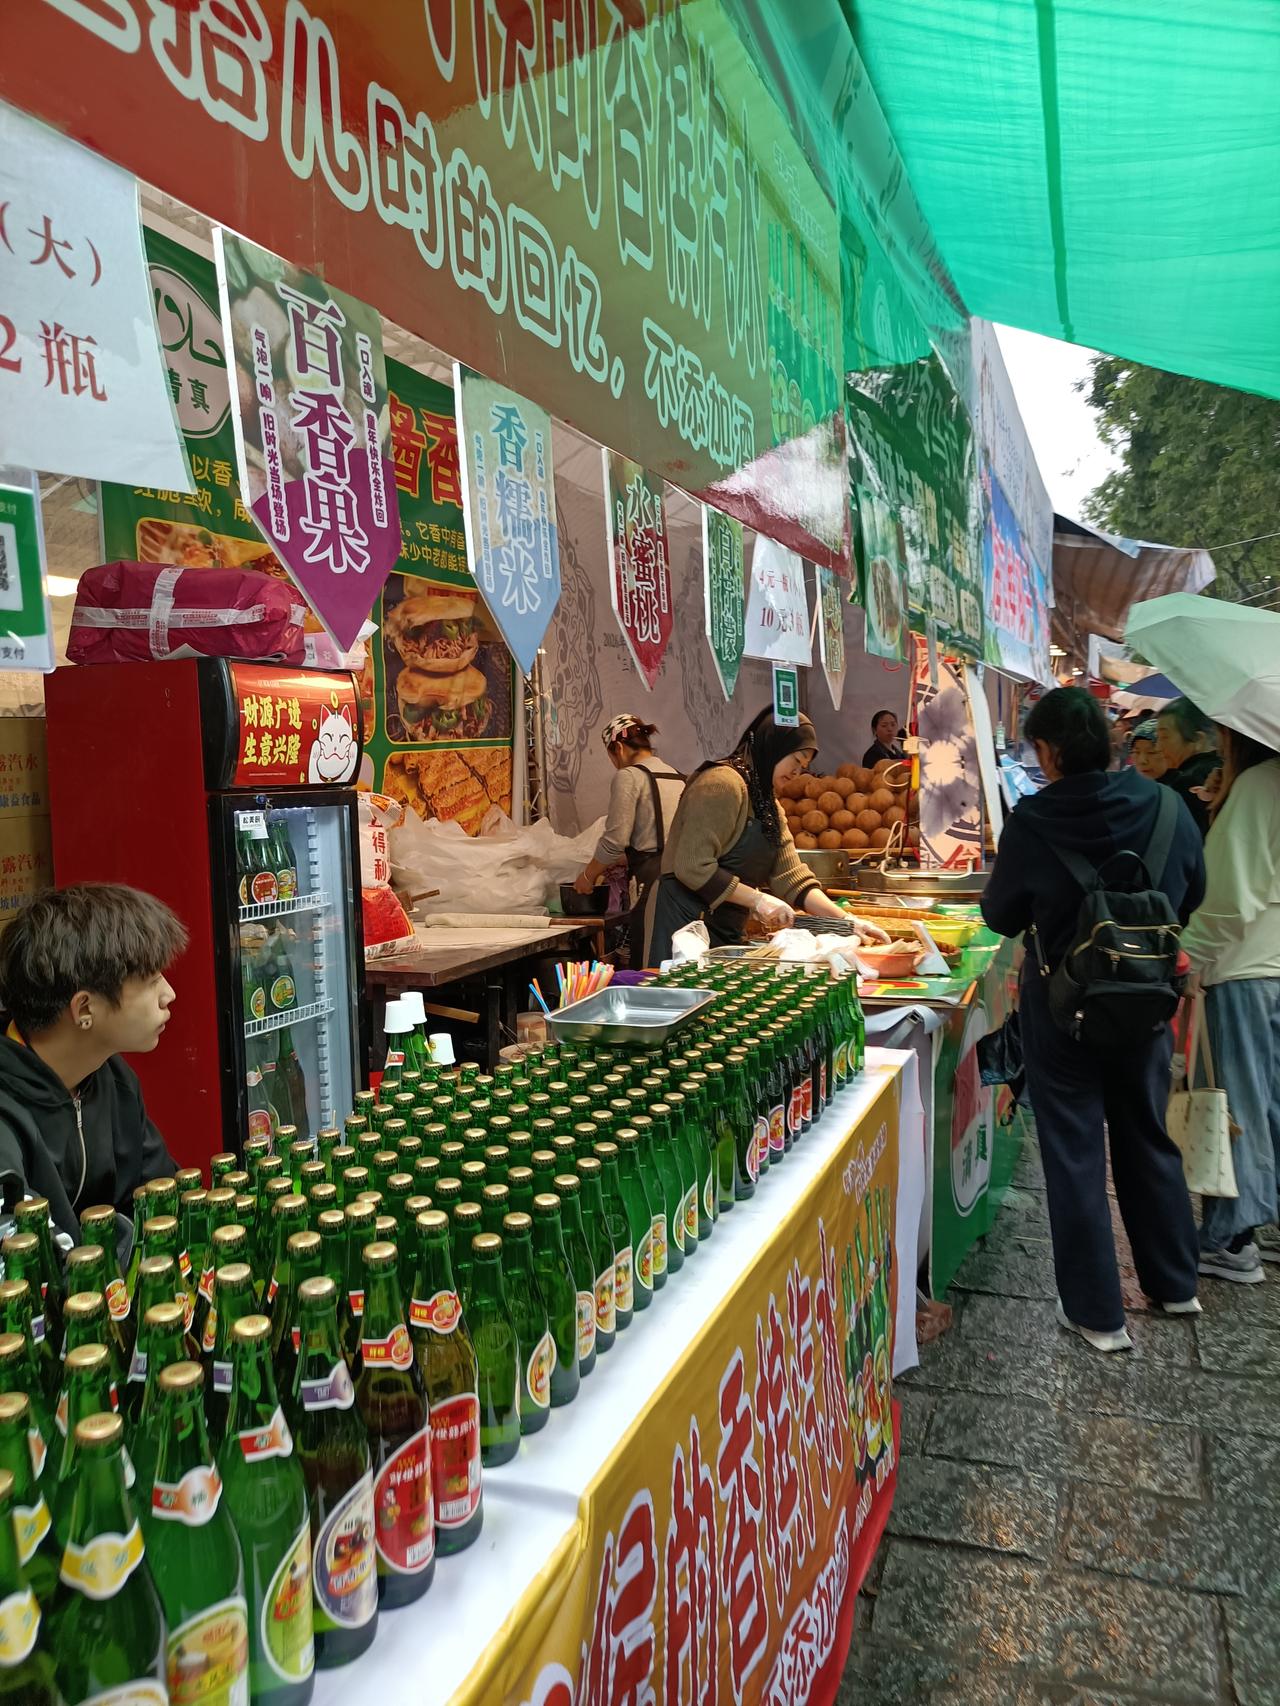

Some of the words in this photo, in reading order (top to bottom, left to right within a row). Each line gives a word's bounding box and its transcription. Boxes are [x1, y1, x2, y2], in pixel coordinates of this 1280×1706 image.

[40, 0, 625, 399] 拾儿时的回忆。
[253, 327, 273, 404] 气泡一响
[275, 279, 372, 573] 百香果
[357, 334, 375, 400] 一口入魂
[261, 411, 288, 538] 旧时光当场登场
[492, 403, 542, 615] 香糯米
[626, 474, 661, 643] 水蜜桃
[243, 694, 303, 729] 财源广进
[243, 731, 301, 766] 生意兴隆
